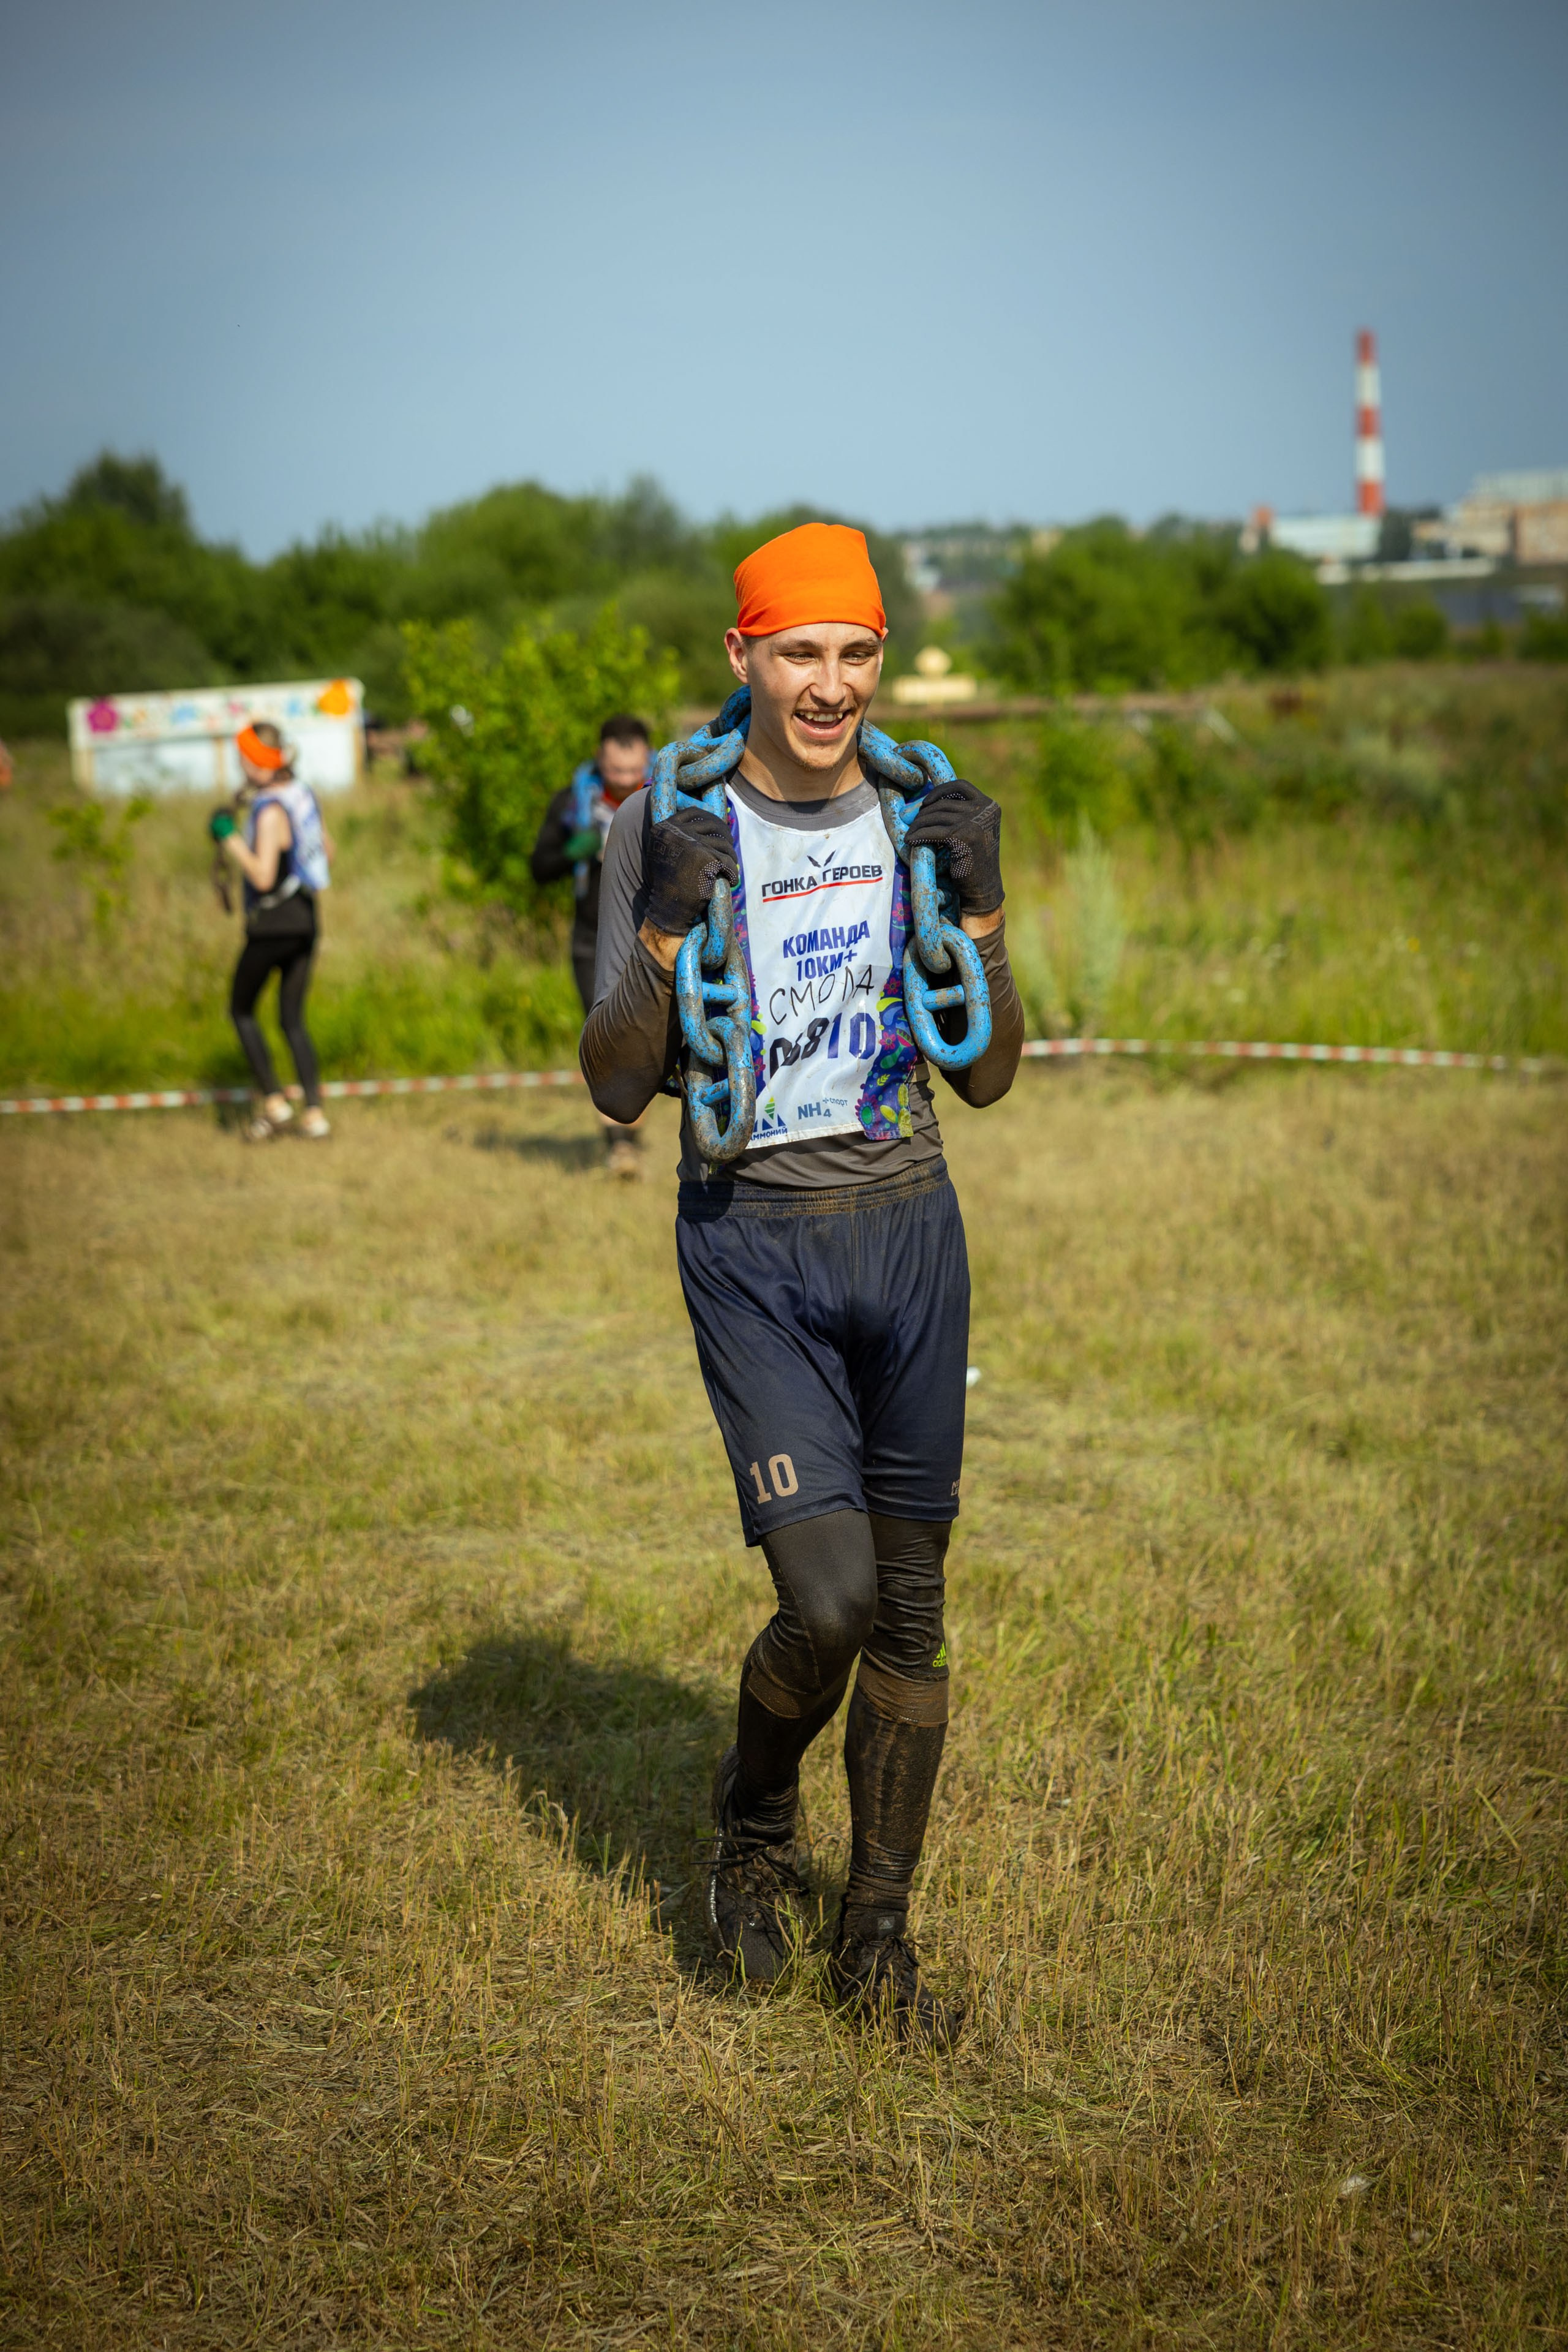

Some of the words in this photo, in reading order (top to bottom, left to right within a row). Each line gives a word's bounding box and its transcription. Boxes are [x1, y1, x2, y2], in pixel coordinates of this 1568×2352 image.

[762, 876, 818, 897] ГОНКА
[823, 865, 883, 882] ГЕРОЕВ
[783, 921, 870, 959] КОМАНДА
[769, 964, 874, 1025] СМОЛА
[750, 1453, 799, 1504] 10
